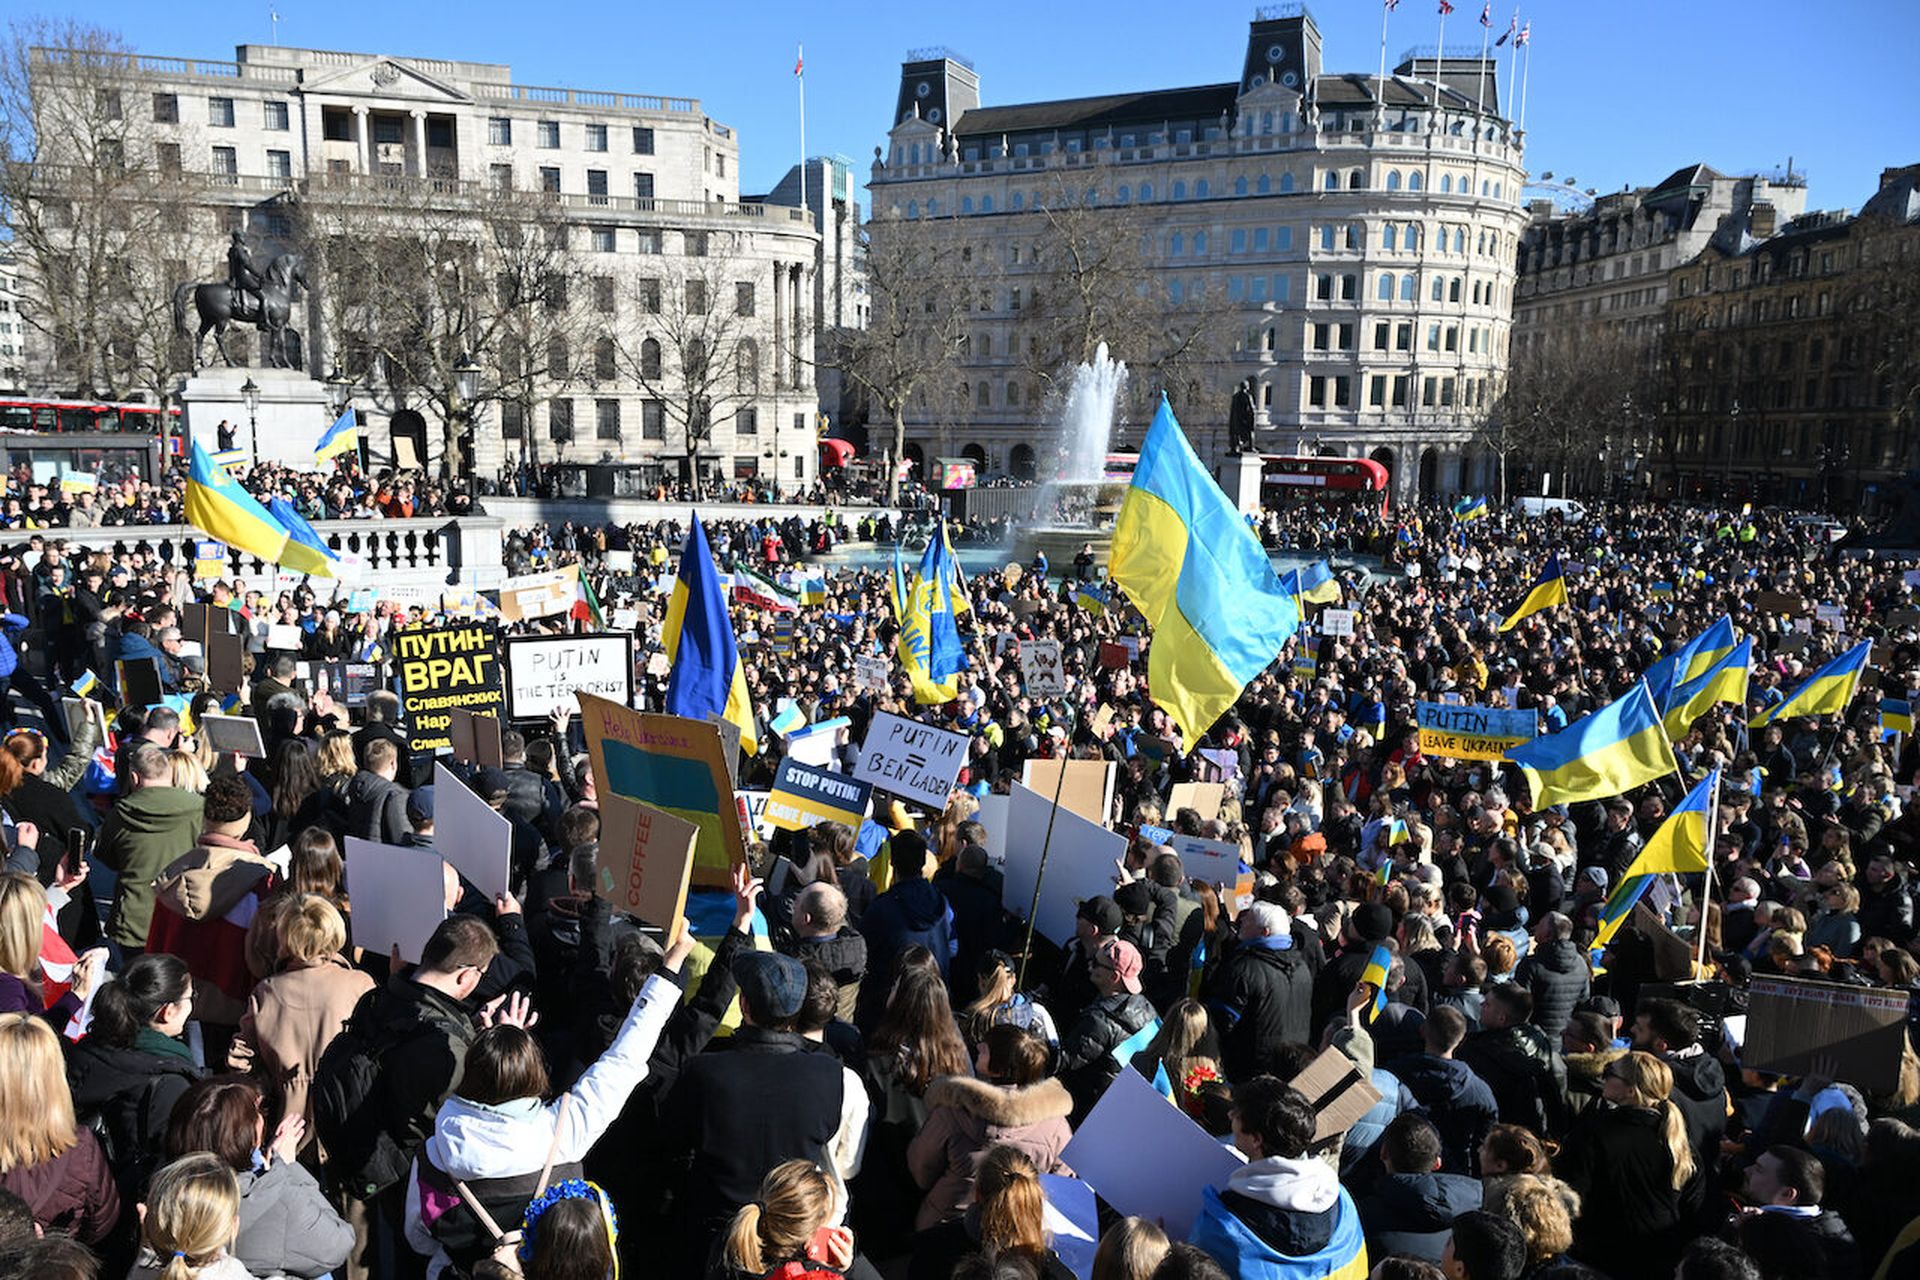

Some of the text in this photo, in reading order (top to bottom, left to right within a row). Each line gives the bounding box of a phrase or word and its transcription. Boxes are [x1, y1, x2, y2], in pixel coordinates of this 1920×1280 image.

[400, 628, 494, 659] ПУТИН-
[403, 654, 493, 693] ВРАГ
[405, 690, 502, 712] Славянских
[516, 685, 543, 699] THE
[1425, 708, 1488, 733] PUTIN
[889, 723, 958, 757] PUTIN
[1424, 735, 1455, 750] LEAVE
[785, 767, 862, 802] STOP PUTIN!
[867, 753, 953, 797] BEN LADEN
[628, 814, 652, 906] COFFEE
